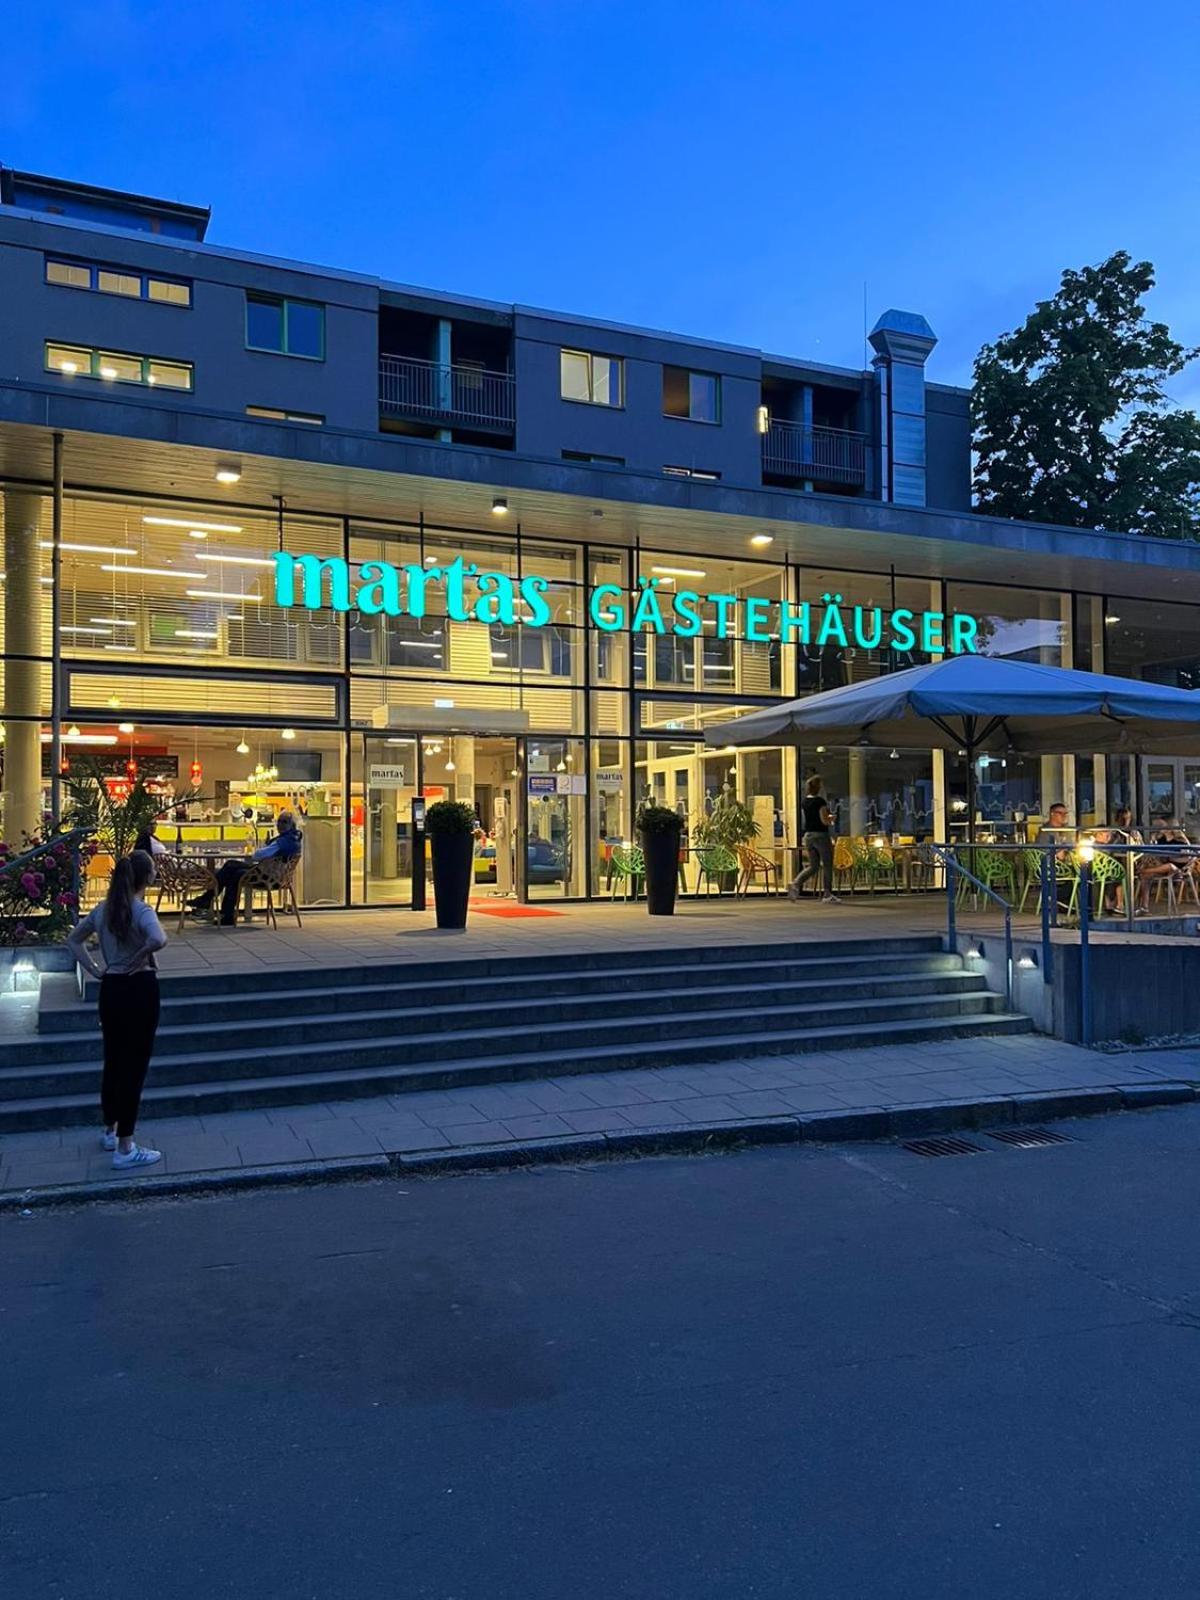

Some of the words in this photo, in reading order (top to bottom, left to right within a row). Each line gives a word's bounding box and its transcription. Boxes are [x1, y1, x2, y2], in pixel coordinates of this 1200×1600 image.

[272, 551, 550, 627] martas
[590, 576, 978, 654] GÄSTEHÄUSER
[371, 769, 404, 778] martas
[596, 772, 623, 780] martas
